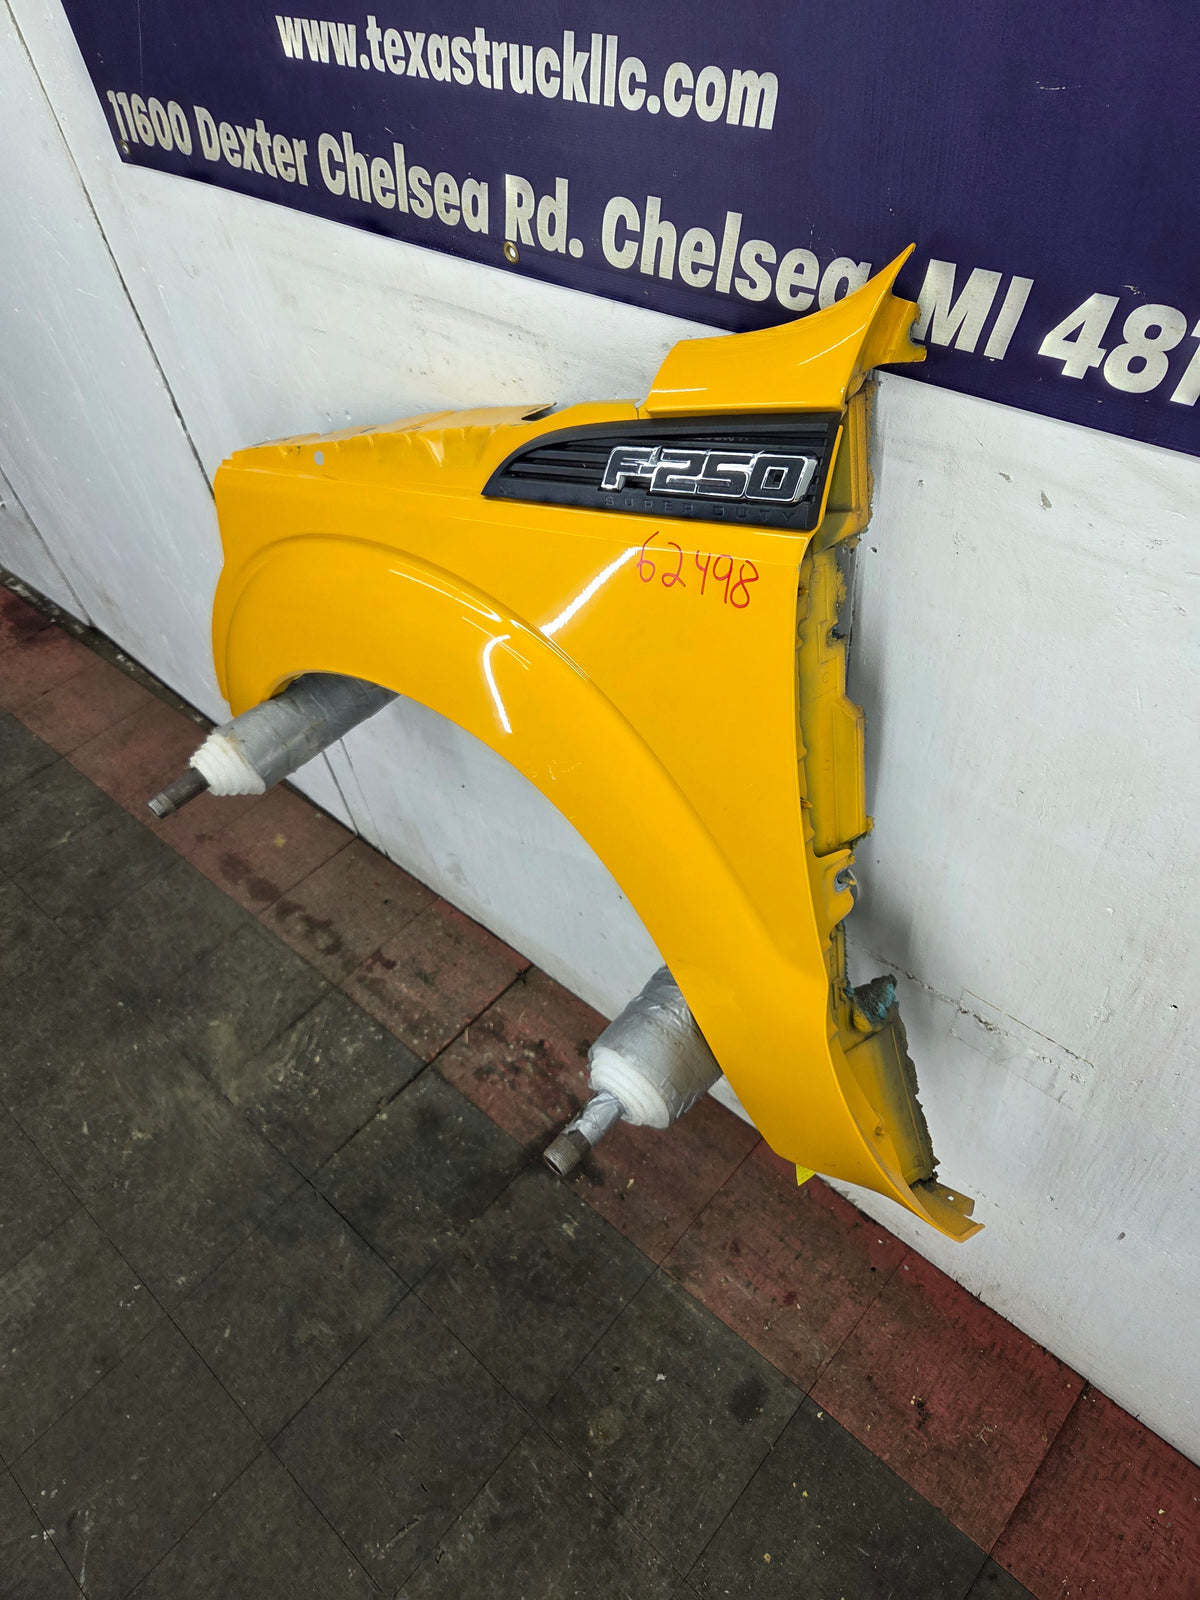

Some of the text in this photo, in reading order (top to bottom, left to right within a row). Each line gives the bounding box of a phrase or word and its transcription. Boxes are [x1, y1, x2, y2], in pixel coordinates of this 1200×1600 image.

[274, 14, 779, 131] www.texastruckllc.com
[106, 89, 193, 156] 11600
[193, 105, 309, 187] Dexter
[317, 131, 489, 235] Chelsea
[504, 173, 584, 259] Rd.
[601, 195, 872, 312] Chelsea
[911, 258, 1035, 361] MI
[600, 445, 818, 503] F-250
[604, 495, 796, 523] SUPER DUTY
[636, 530, 759, 609] 62498
